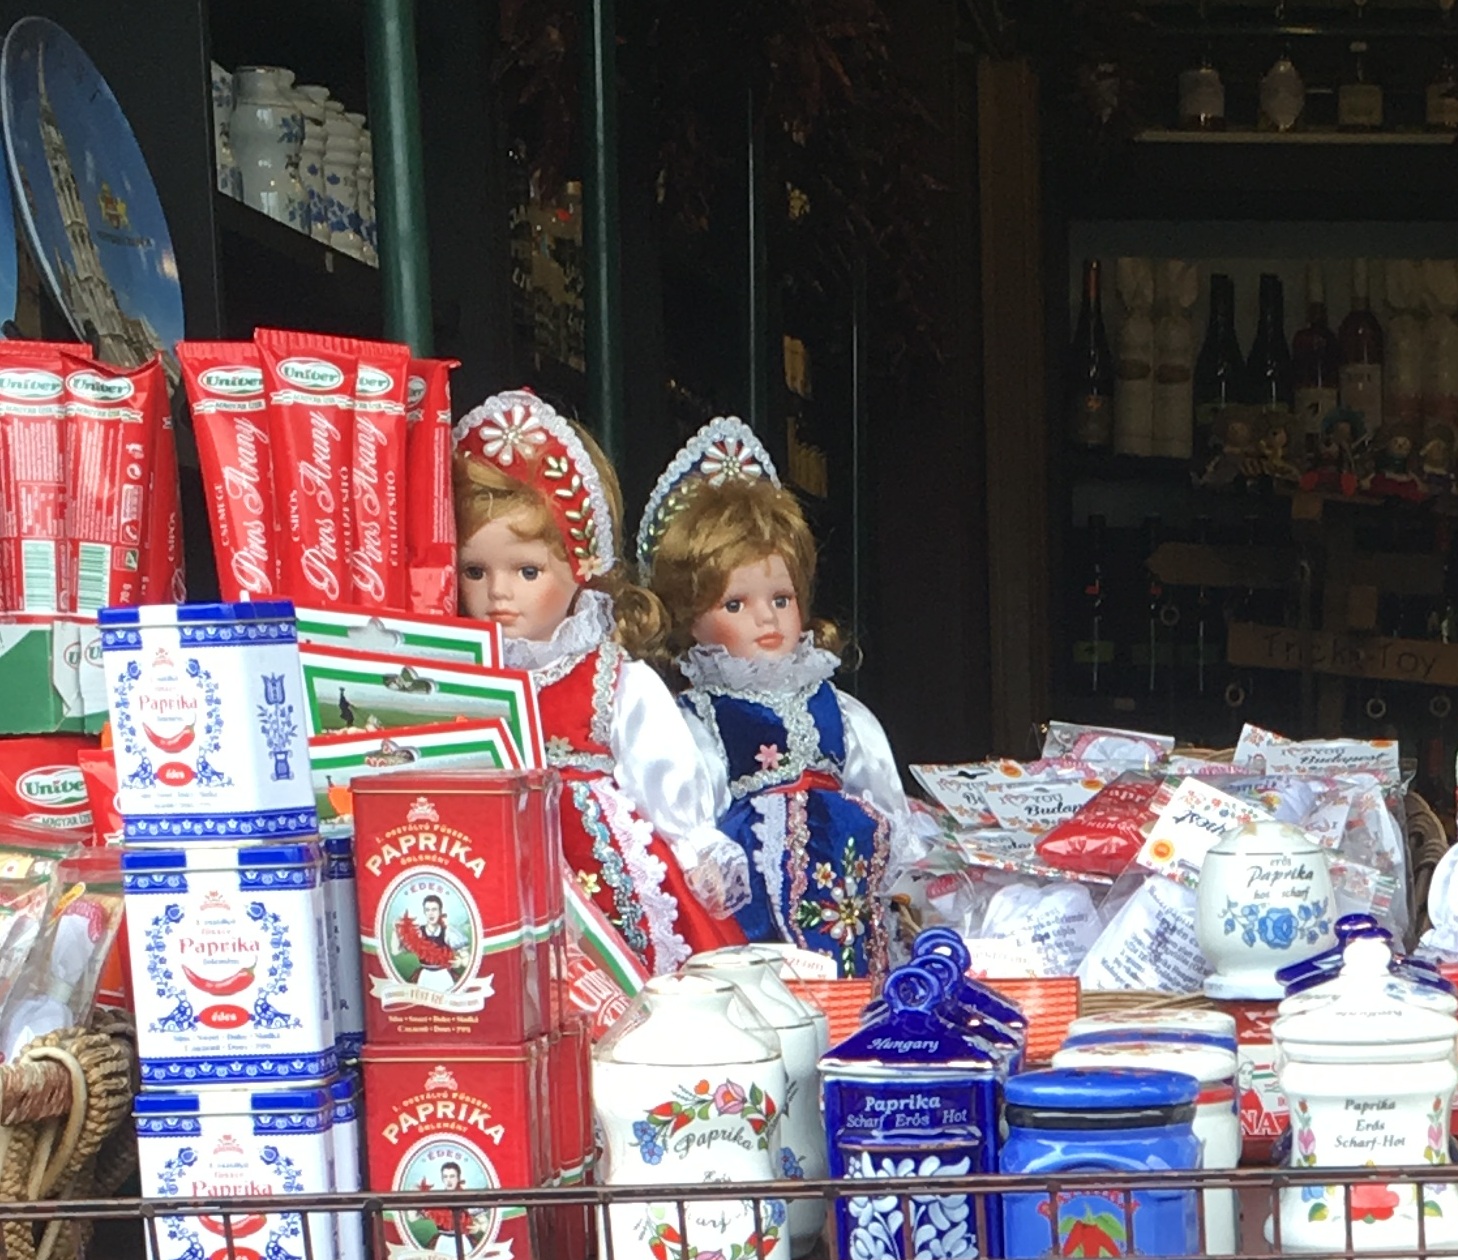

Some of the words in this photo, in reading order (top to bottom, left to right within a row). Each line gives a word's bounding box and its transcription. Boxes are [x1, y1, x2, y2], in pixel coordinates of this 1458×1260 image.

[359, 376, 387, 388] ver
[222, 416, 270, 516] Arany
[299, 410, 342, 514] Arany
[231, 519, 273, 595] Piros
[301, 517, 340, 601] Piros
[138, 694, 198, 714] Paprika
[25, 780, 85, 796] Unive
[79, 813, 93, 825] ÍZE
[1024, 801, 1083, 817] Budap
[364, 832, 487, 880] PAPRIKA
[1246, 865, 1314, 888] Paprika
[178, 936, 260, 957] Paprika
[867, 1037, 939, 1052] Hungary
[864, 1094, 942, 1115] Paprika
[1343, 1098, 1398, 1115] Paprika
[381, 1100, 506, 1146] PAPRIKA
[846, 1114, 885, 1131] Scharf
[942, 1109, 968, 1125] Hot
[673, 1125, 755, 1160] Paprika
